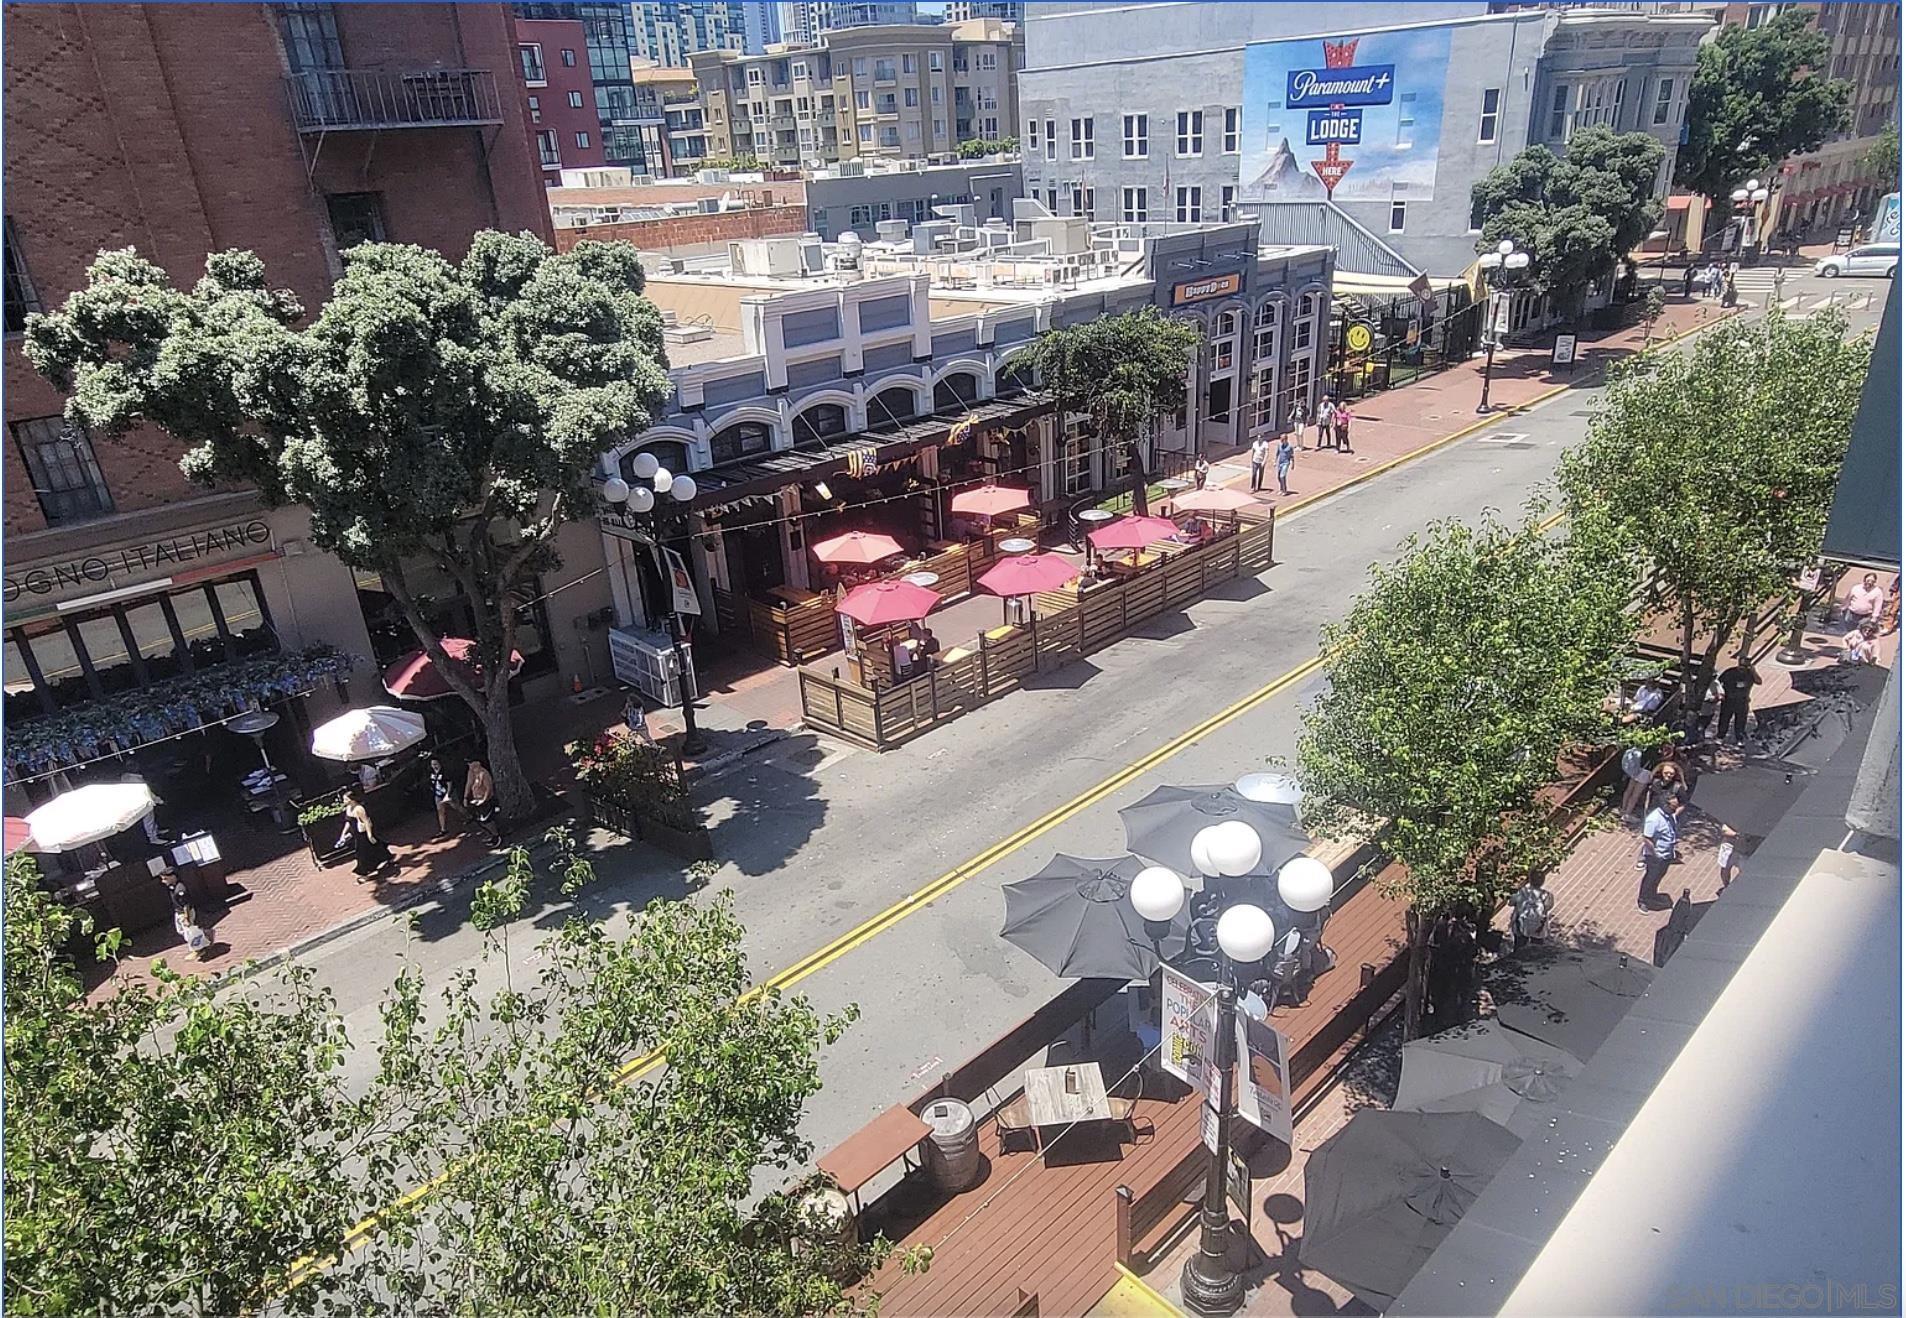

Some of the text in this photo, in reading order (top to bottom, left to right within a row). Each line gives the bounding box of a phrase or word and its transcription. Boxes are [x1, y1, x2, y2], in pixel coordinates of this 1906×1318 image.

[1290, 71, 1390, 101] Paramount+
[1310, 118, 1360, 141] LODGE
[1322, 166, 1342, 176] HERE
[120, 520, 269, 574] ITALIANO
[1166, 975, 1213, 1008] CELEBRATING
[1180, 993, 1199, 1010] THE
[1170, 1015, 1206, 1043] ARTS
